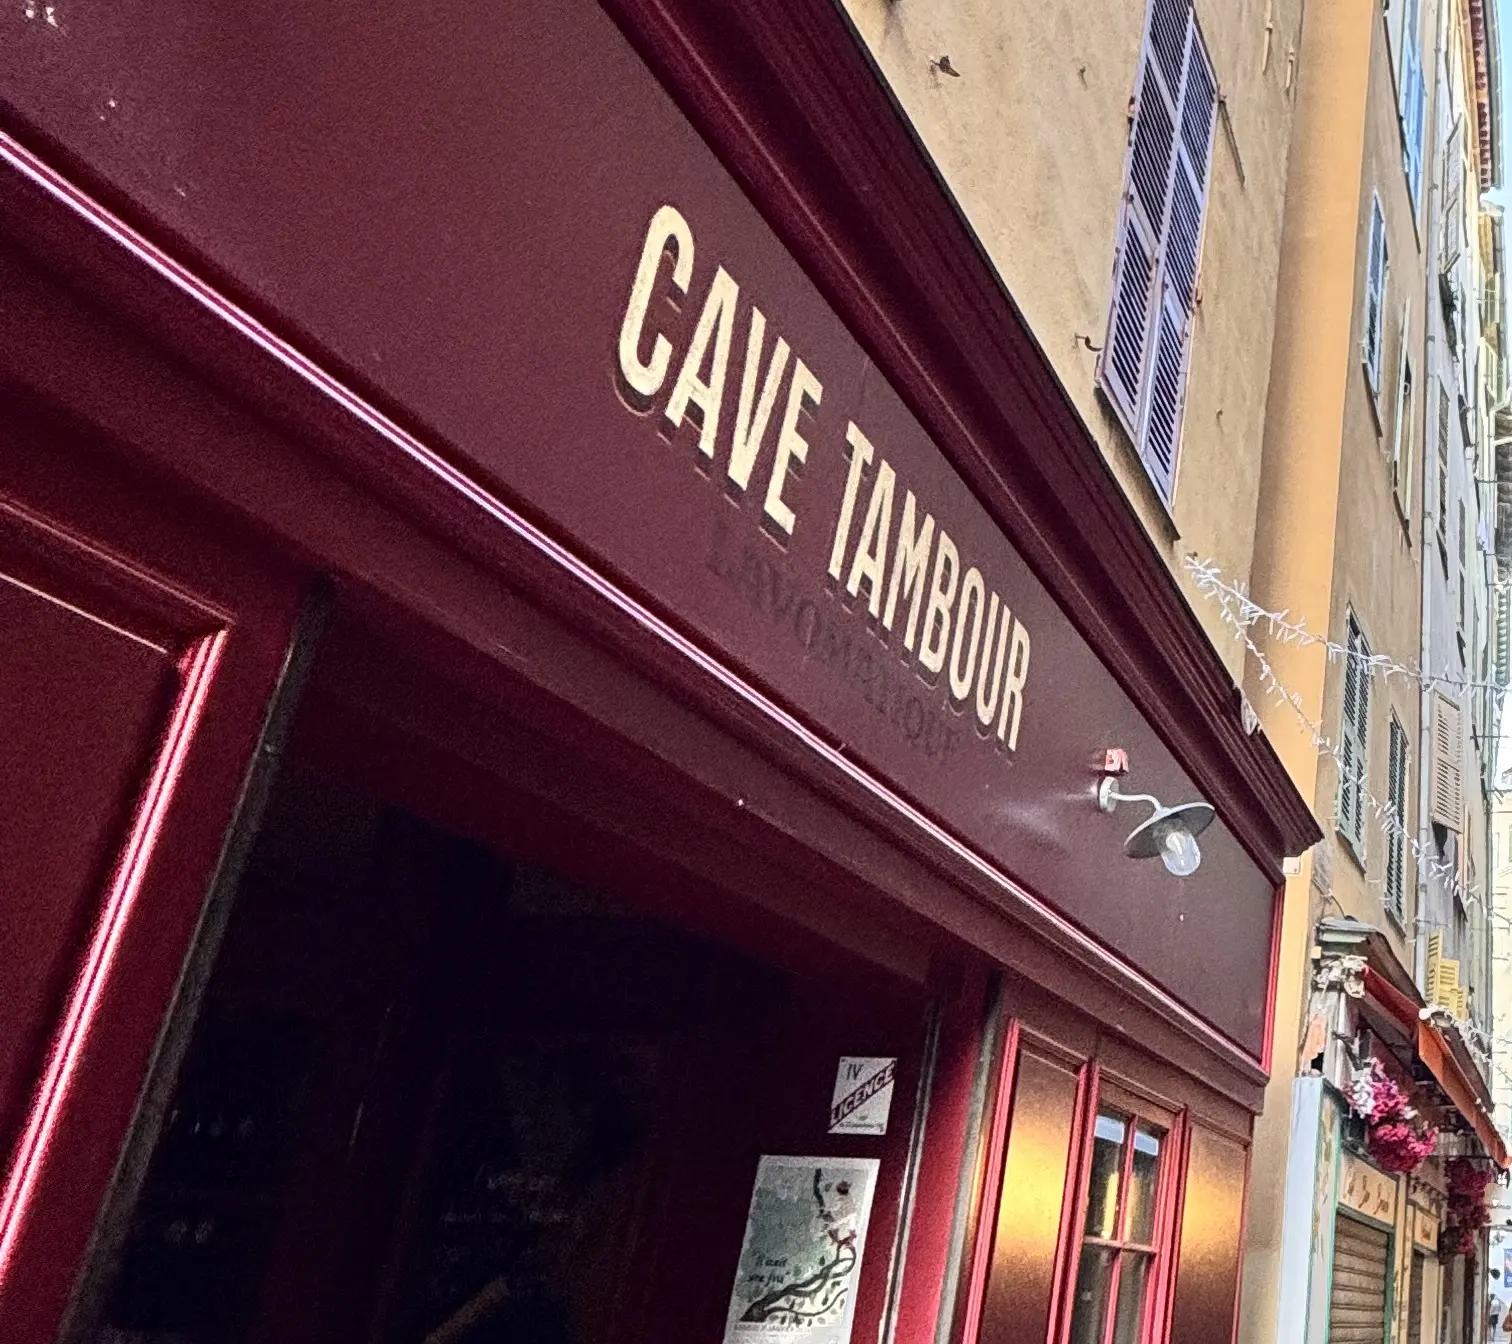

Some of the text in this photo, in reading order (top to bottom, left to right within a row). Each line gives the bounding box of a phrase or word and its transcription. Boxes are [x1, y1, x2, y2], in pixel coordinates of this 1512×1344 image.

[617, 205, 1031, 752] CAVE TAMBOUR
[829, 1062, 896, 1128] LICENCE
[846, 1063, 865, 1081] IV
